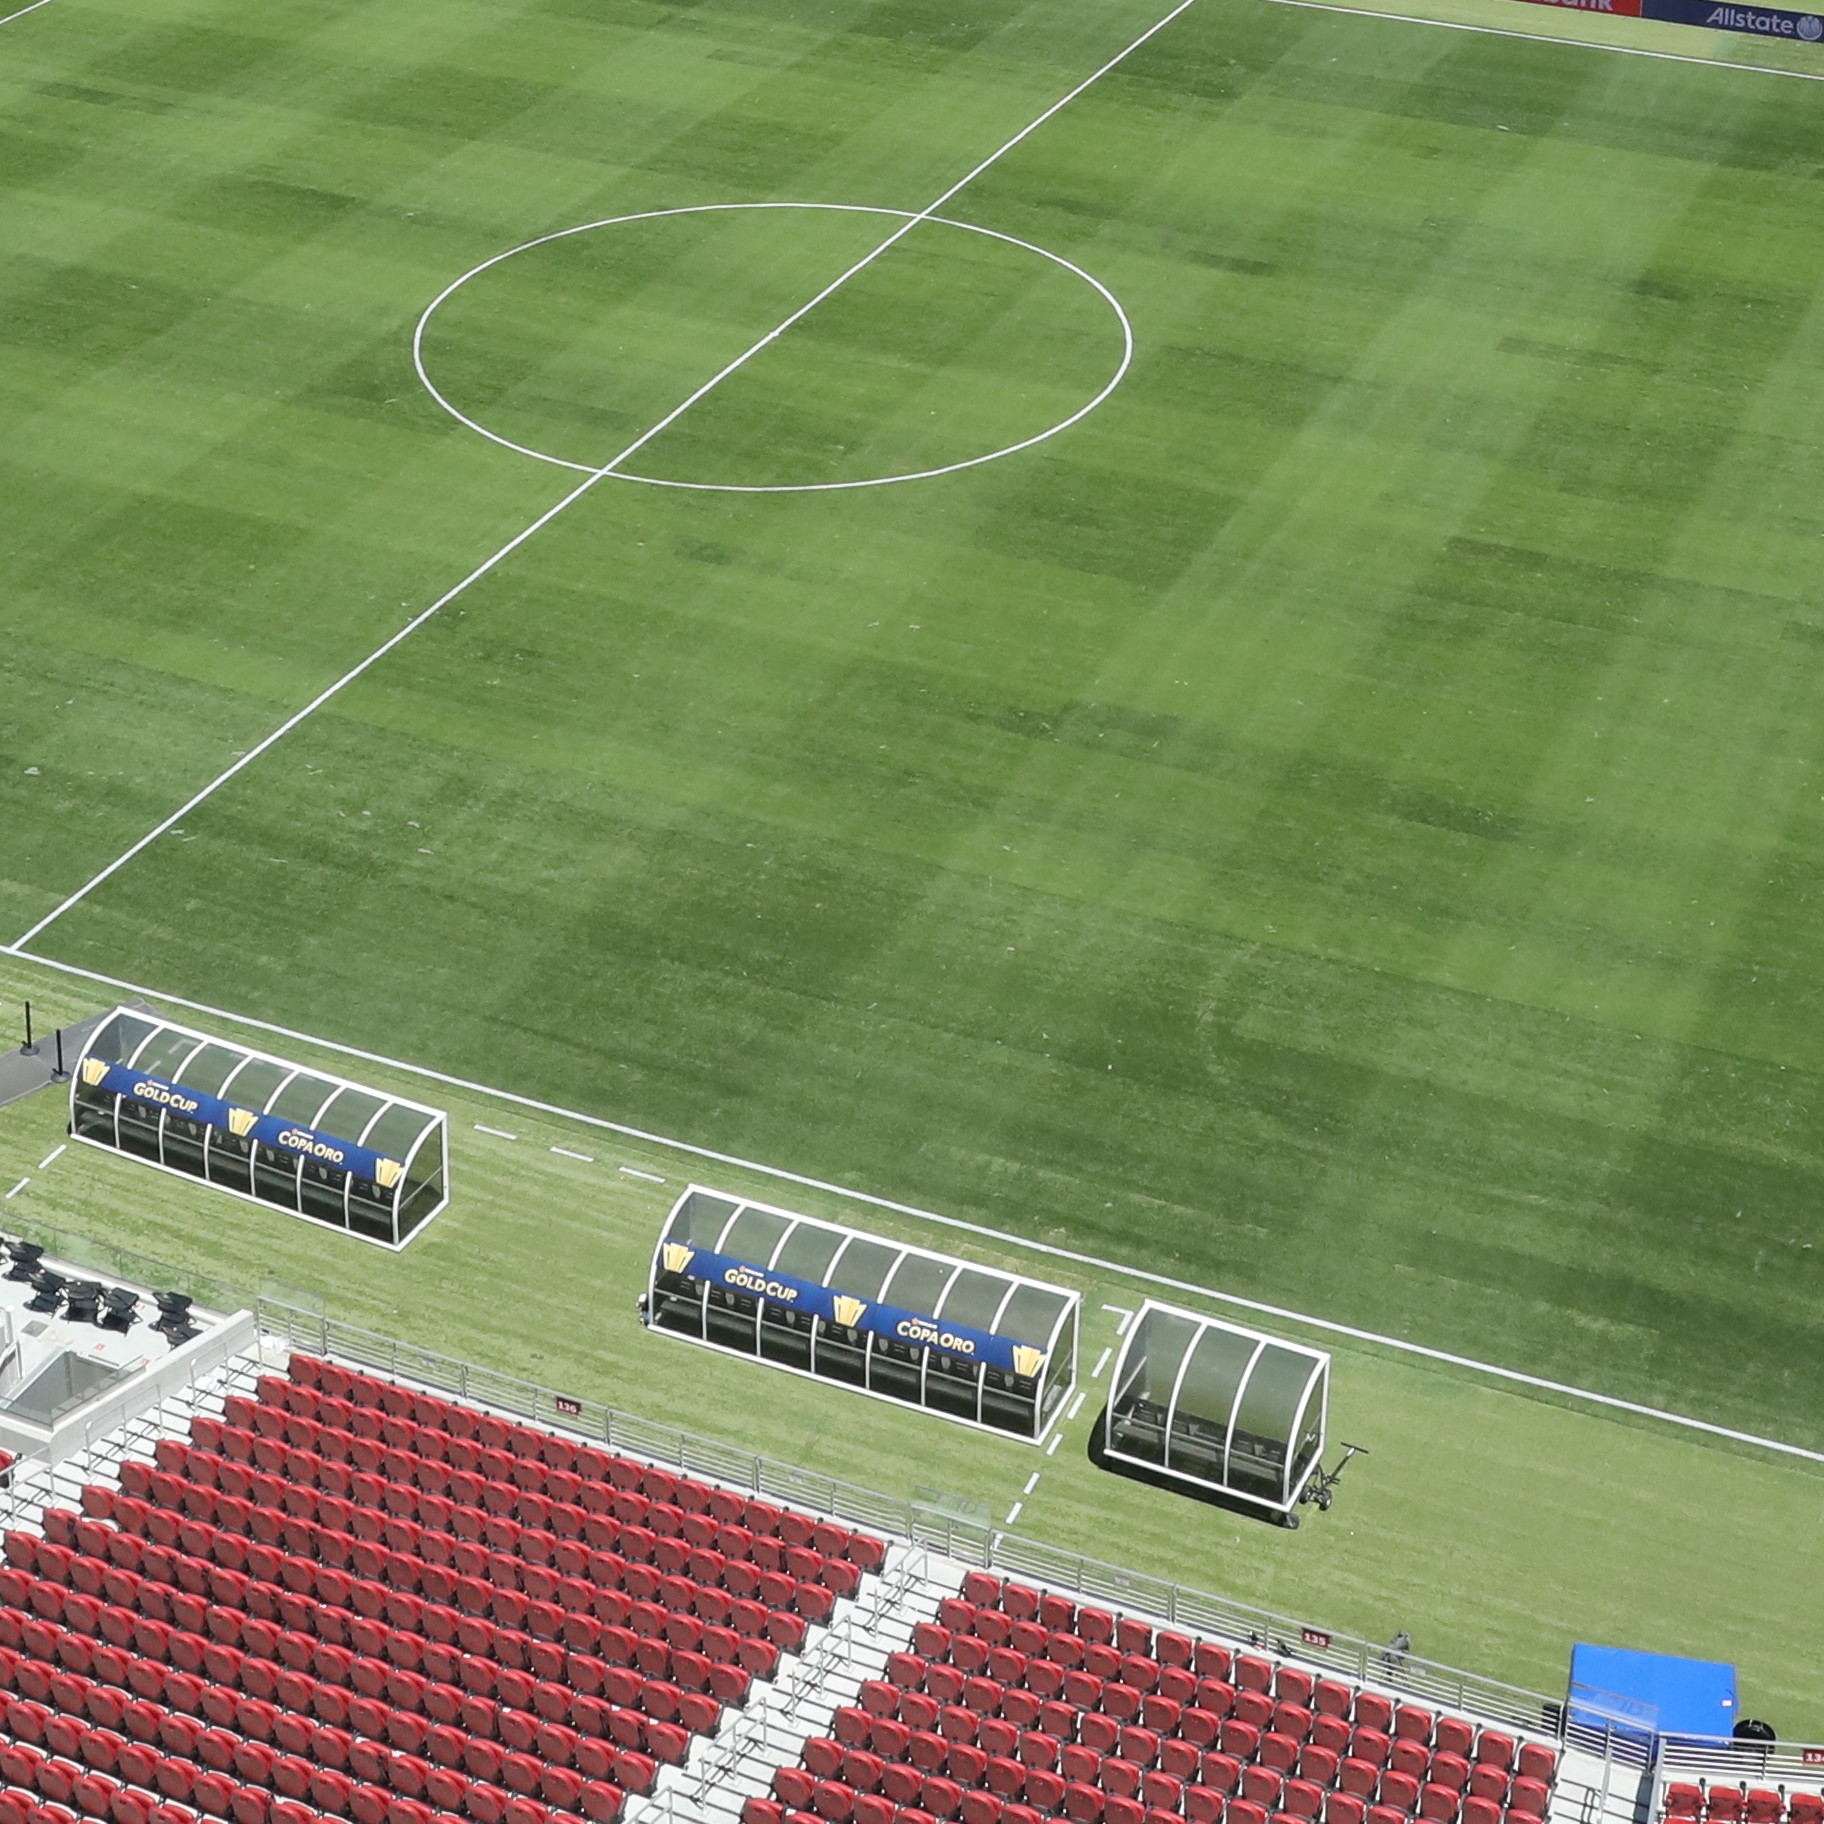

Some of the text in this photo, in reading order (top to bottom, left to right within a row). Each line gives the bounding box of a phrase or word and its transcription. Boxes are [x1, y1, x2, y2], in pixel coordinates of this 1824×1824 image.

[1705, 6, 1794, 34] Allstate
[133, 1081, 198, 1113] GOLD CUP
[278, 1130, 344, 1164] COPA ORO
[724, 1268, 798, 1302] GOLD CUP
[897, 1321, 975, 1354] COPA ORO
[557, 1400, 578, 1413] 136
[1304, 1633, 1327, 1646] 135
